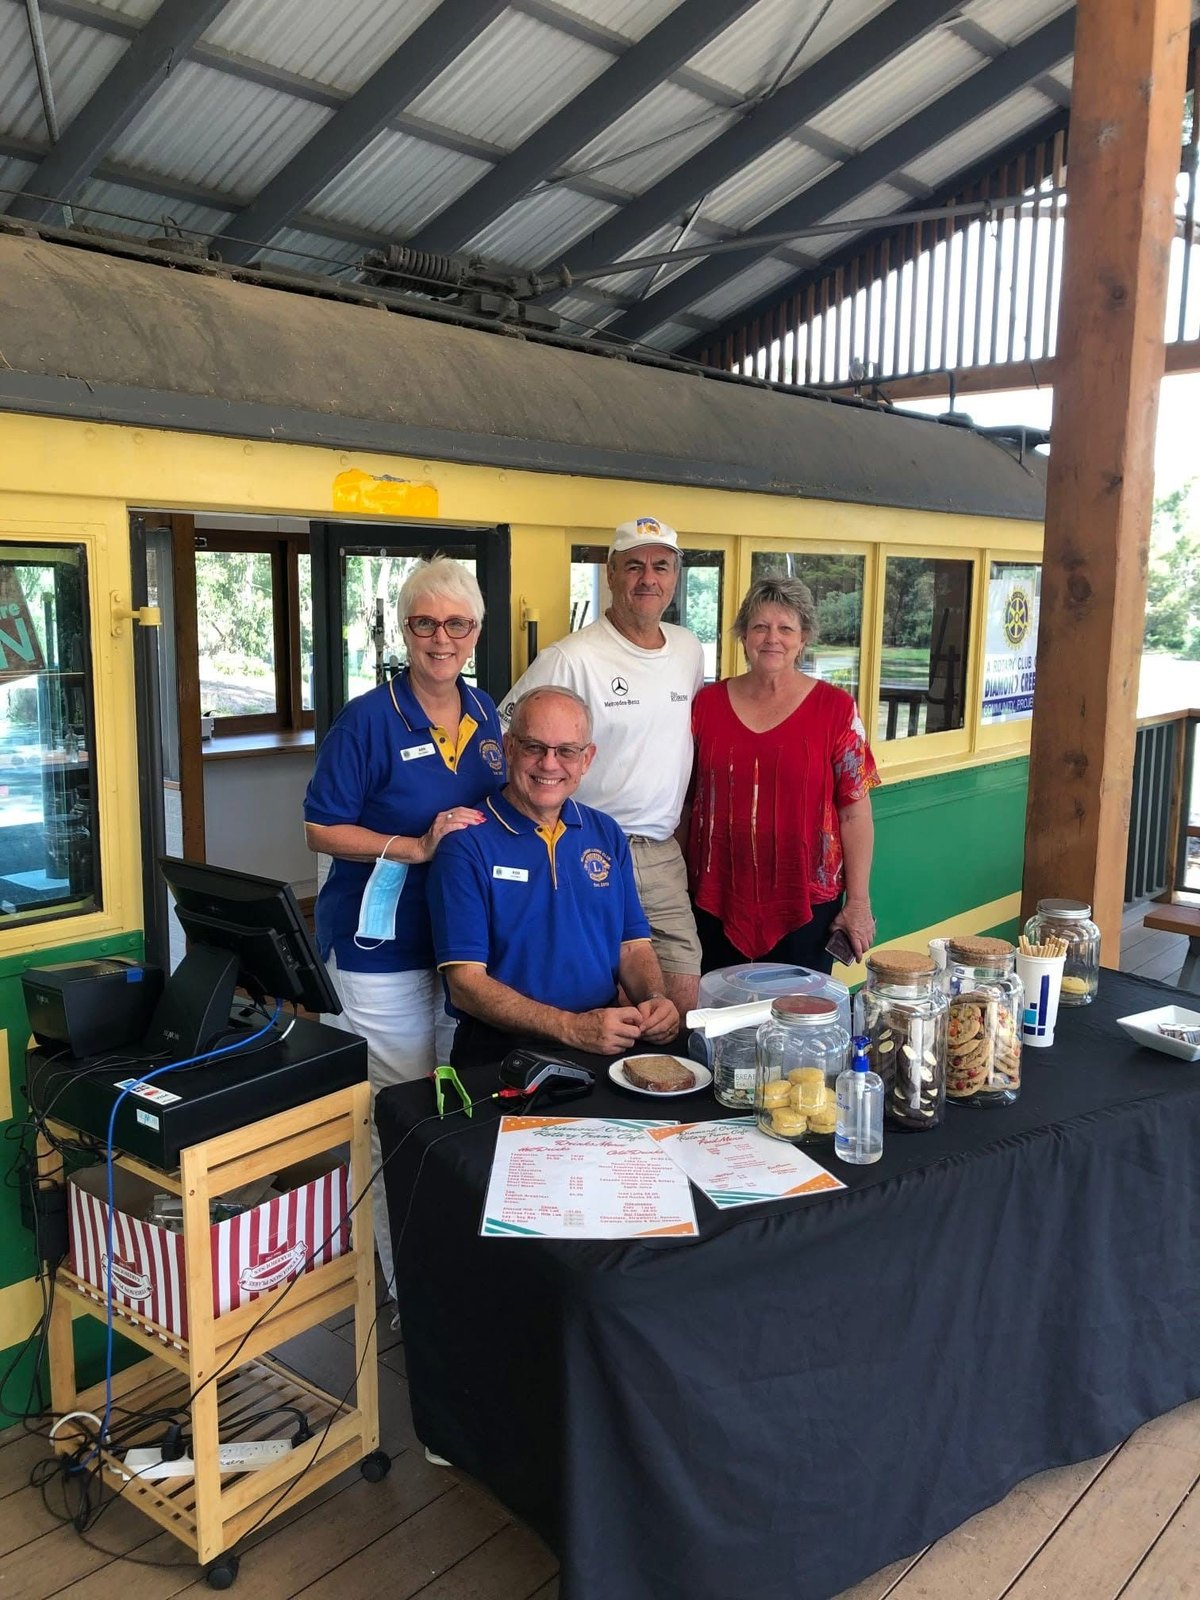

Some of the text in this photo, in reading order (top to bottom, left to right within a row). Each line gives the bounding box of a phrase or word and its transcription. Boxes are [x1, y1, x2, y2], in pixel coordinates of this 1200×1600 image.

[1017, 655, 1032, 670] CLUB
[985, 671, 1036, 698] DIAMOND CREE
[604, 699, 640, 708] Mercedes-Benz
[592, 861, 601, 873] L
[540, 1124, 605, 1132] Diamond
[532, 1130, 578, 1140] Rotary
[719, 1135, 745, 1143] Menu
